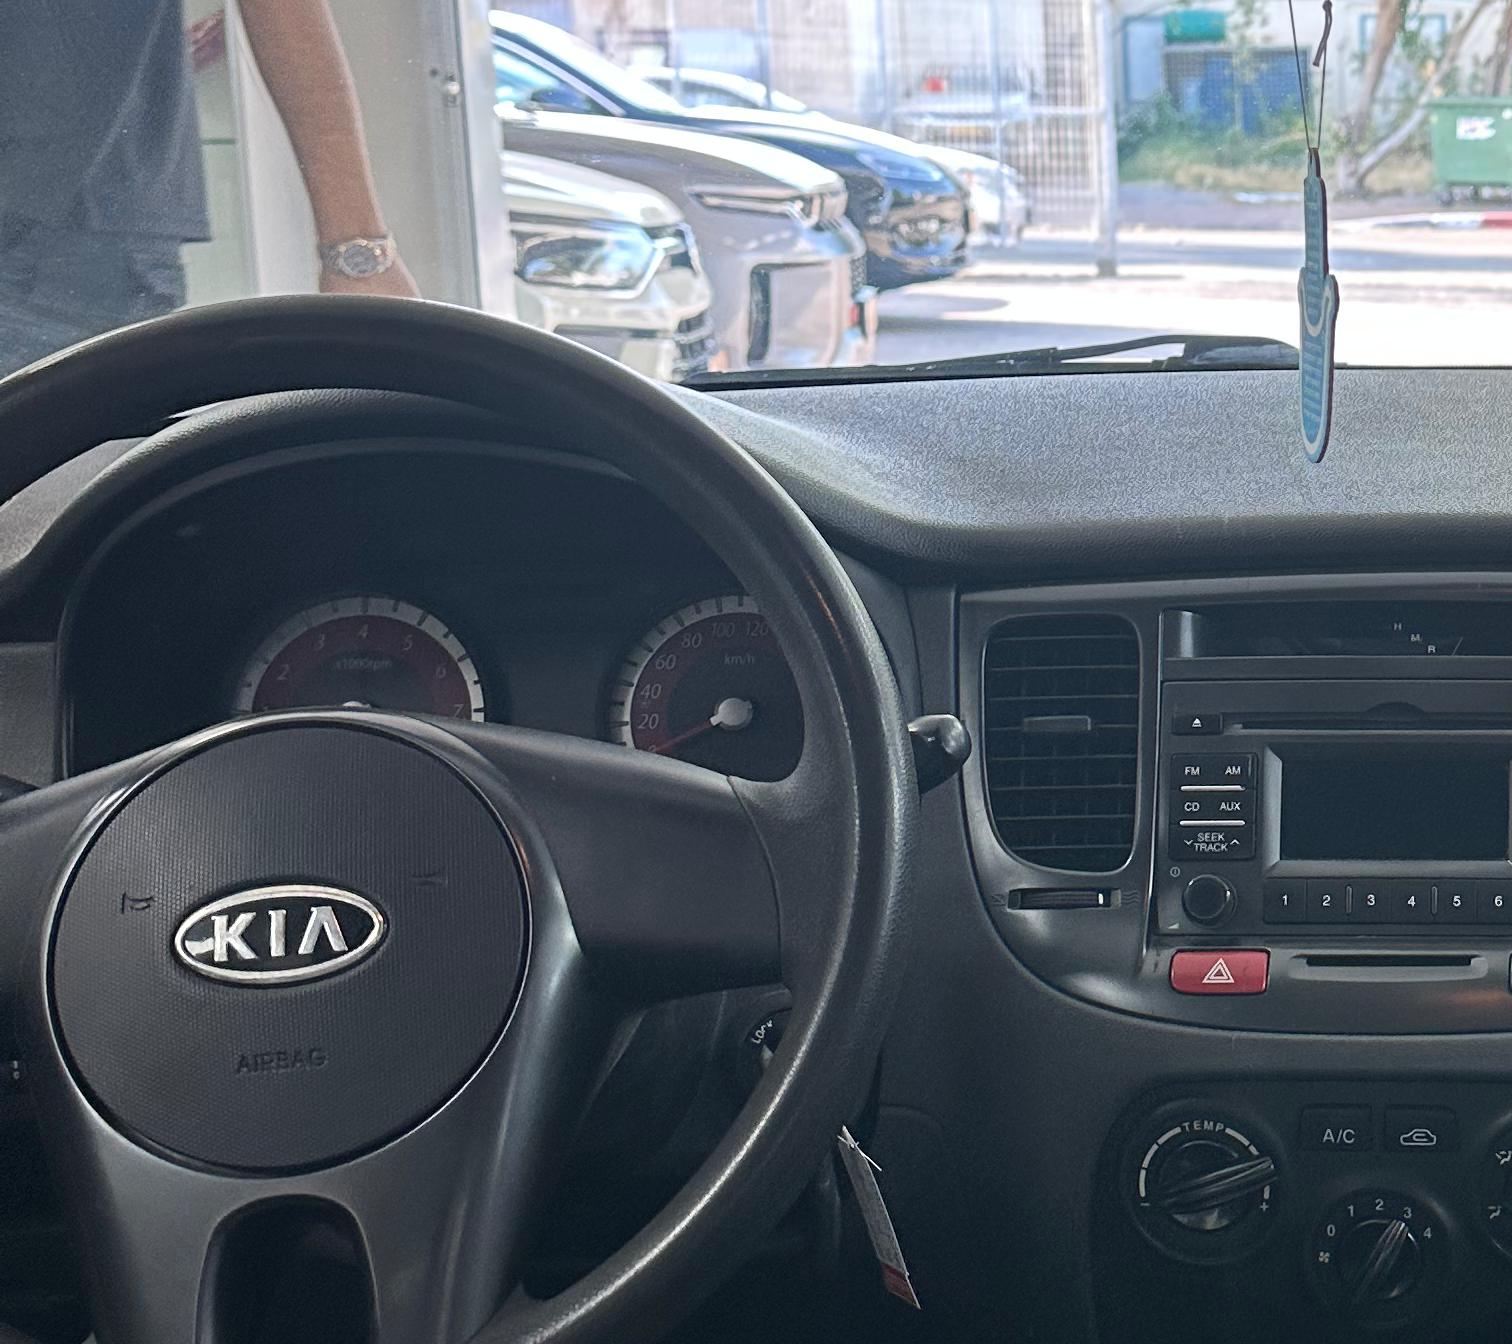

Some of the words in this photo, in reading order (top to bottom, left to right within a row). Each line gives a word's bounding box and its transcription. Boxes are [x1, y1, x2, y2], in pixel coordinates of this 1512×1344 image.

[711, 622, 736, 638] 100
[680, 632, 703, 648] 80
[1427, 644, 1436, 654] R
[655, 654, 676, 670] 60
[277, 664, 290, 680] 2
[640, 684, 662, 700] 40
[638, 714, 660, 730] 20
[1184, 766, 1200, 776] FM
[1224, 766, 1241, 775] AM
[1184, 802, 1200, 812] CD
[1220, 802, 1241, 811] AUX
[1197, 832, 1225, 842] SEEK
[1194, 842, 1228, 852] TRACK
[1282, 894, 1288, 906] 1
[1322, 894, 1332, 906] 2
[1366, 894, 1376, 906] 3
[1407, 895, 1416, 907] 4
[1452, 895, 1462, 907] 5
[1494, 895, 1503, 907] 6
[211, 906, 349, 962] KIA
[236, 1046, 329, 1074] AIRBAG
[1182, 1120, 1225, 1132] TEMP
[1322, 1128, 1356, 1144] A/C
[1347, 1204, 1354, 1217] 1
[1375, 1198, 1384, 1211] 2
[1403, 1206, 1412, 1219] 3
[1326, 1224, 1336, 1236] 0
[1423, 1227, 1432, 1239] 4
